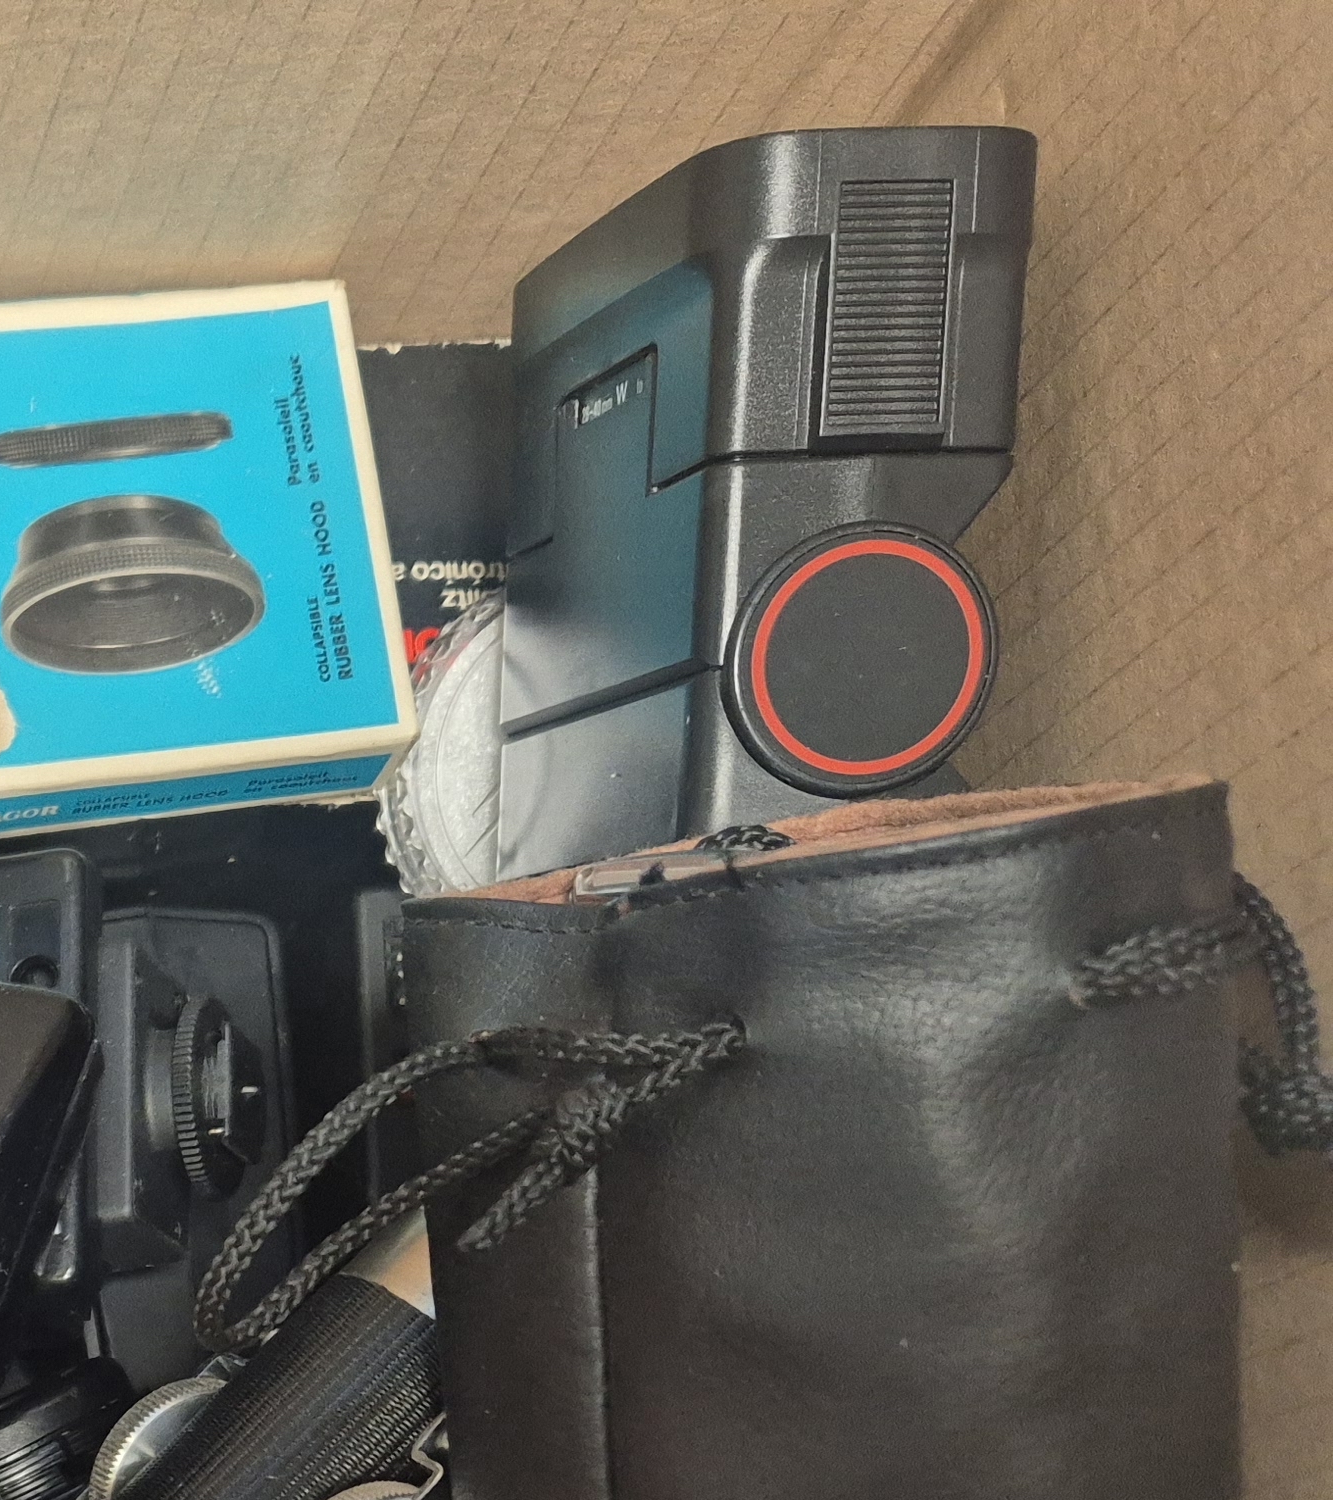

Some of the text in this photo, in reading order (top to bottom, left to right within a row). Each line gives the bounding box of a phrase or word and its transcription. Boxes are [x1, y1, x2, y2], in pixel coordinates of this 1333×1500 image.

[275, 397, 302, 487] Parasoleil
[290, 354, 320, 484] en caoutchouc
[310, 500, 354, 681] RUBBER LENS HOOD
[410, 560, 507, 586] trónico
[307, 596, 331, 683] COLLAPSIBLE
